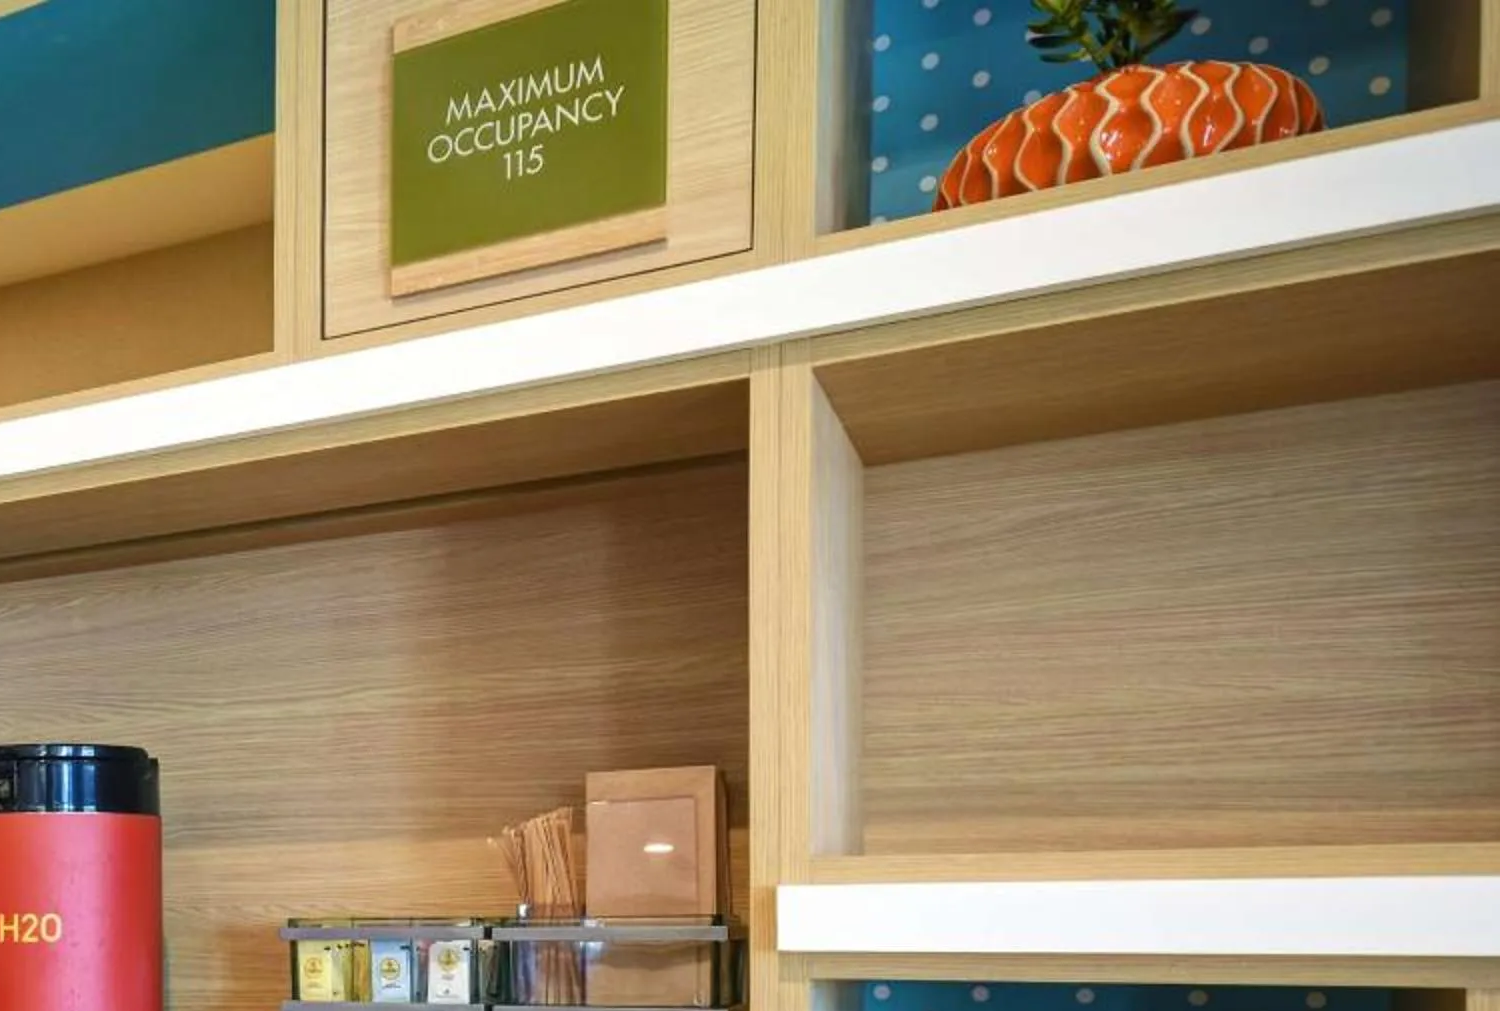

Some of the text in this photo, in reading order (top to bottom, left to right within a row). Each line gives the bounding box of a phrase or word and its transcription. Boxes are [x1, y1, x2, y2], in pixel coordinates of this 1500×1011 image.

[427, 85, 625, 163] OCCUPANCY
[445, 55, 604, 125] MAXIMUM
[503, 144, 544, 180] 115
